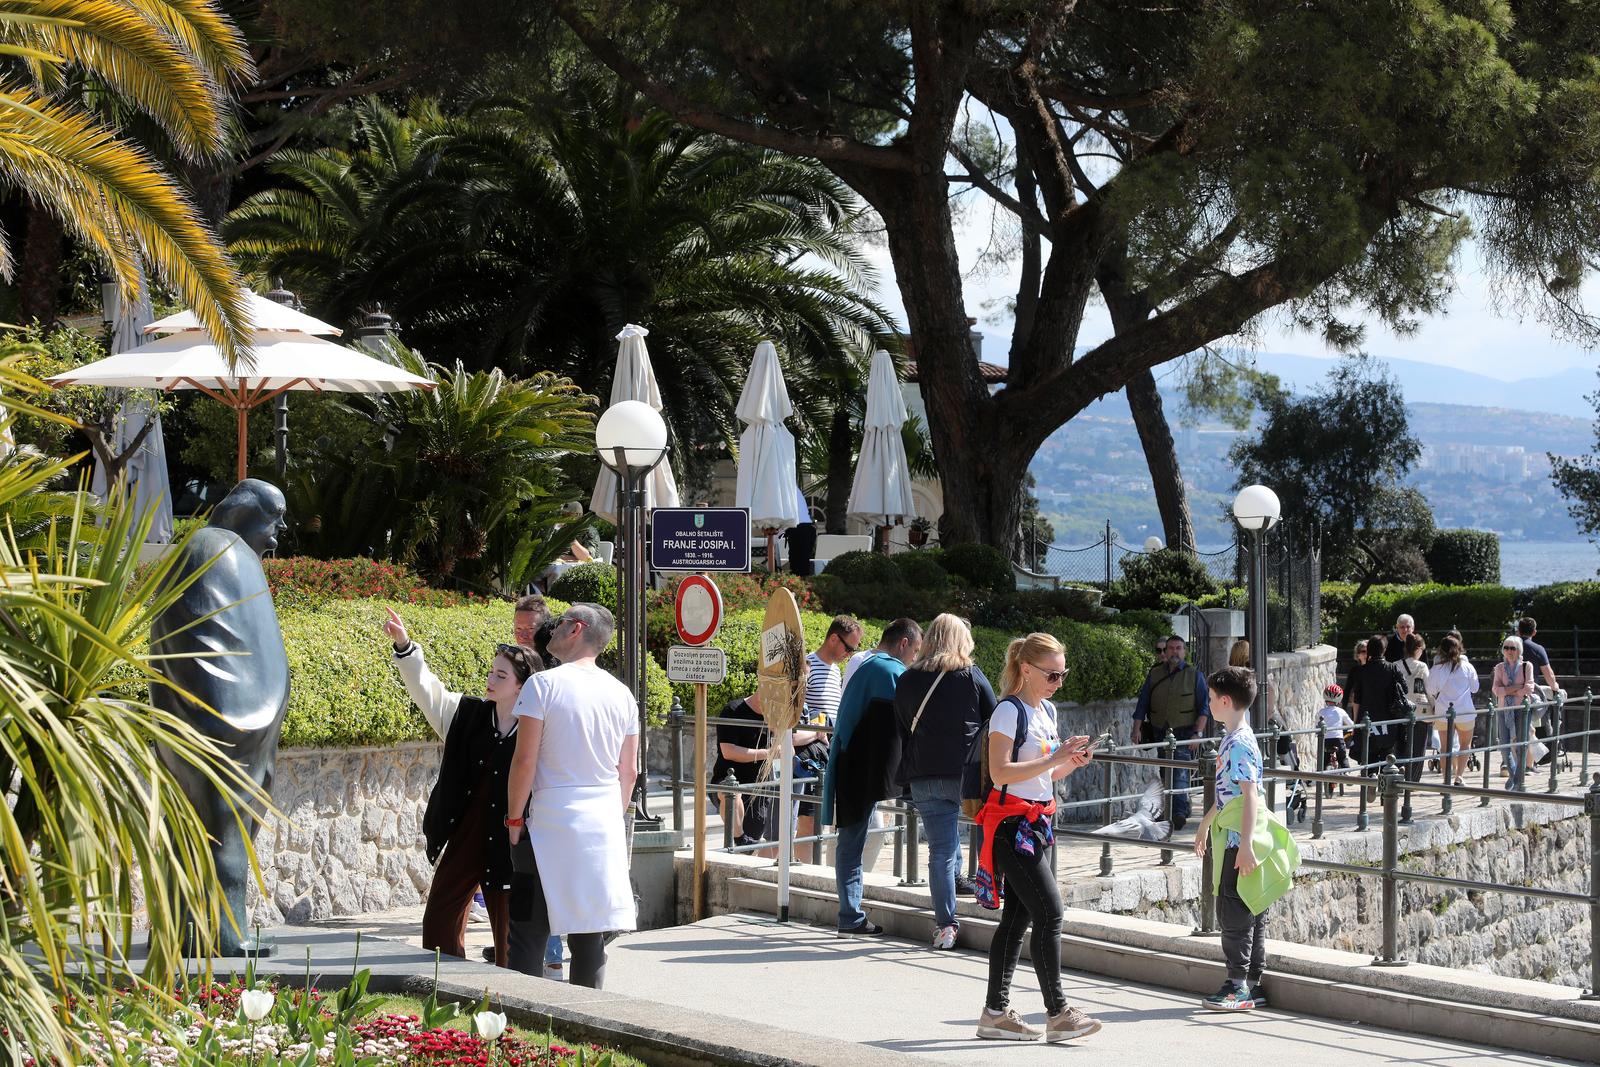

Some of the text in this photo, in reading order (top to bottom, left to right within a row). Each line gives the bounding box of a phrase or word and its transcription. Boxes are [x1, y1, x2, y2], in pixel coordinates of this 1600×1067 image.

[663, 540, 736, 550] FRANJE JOSIPA I.
